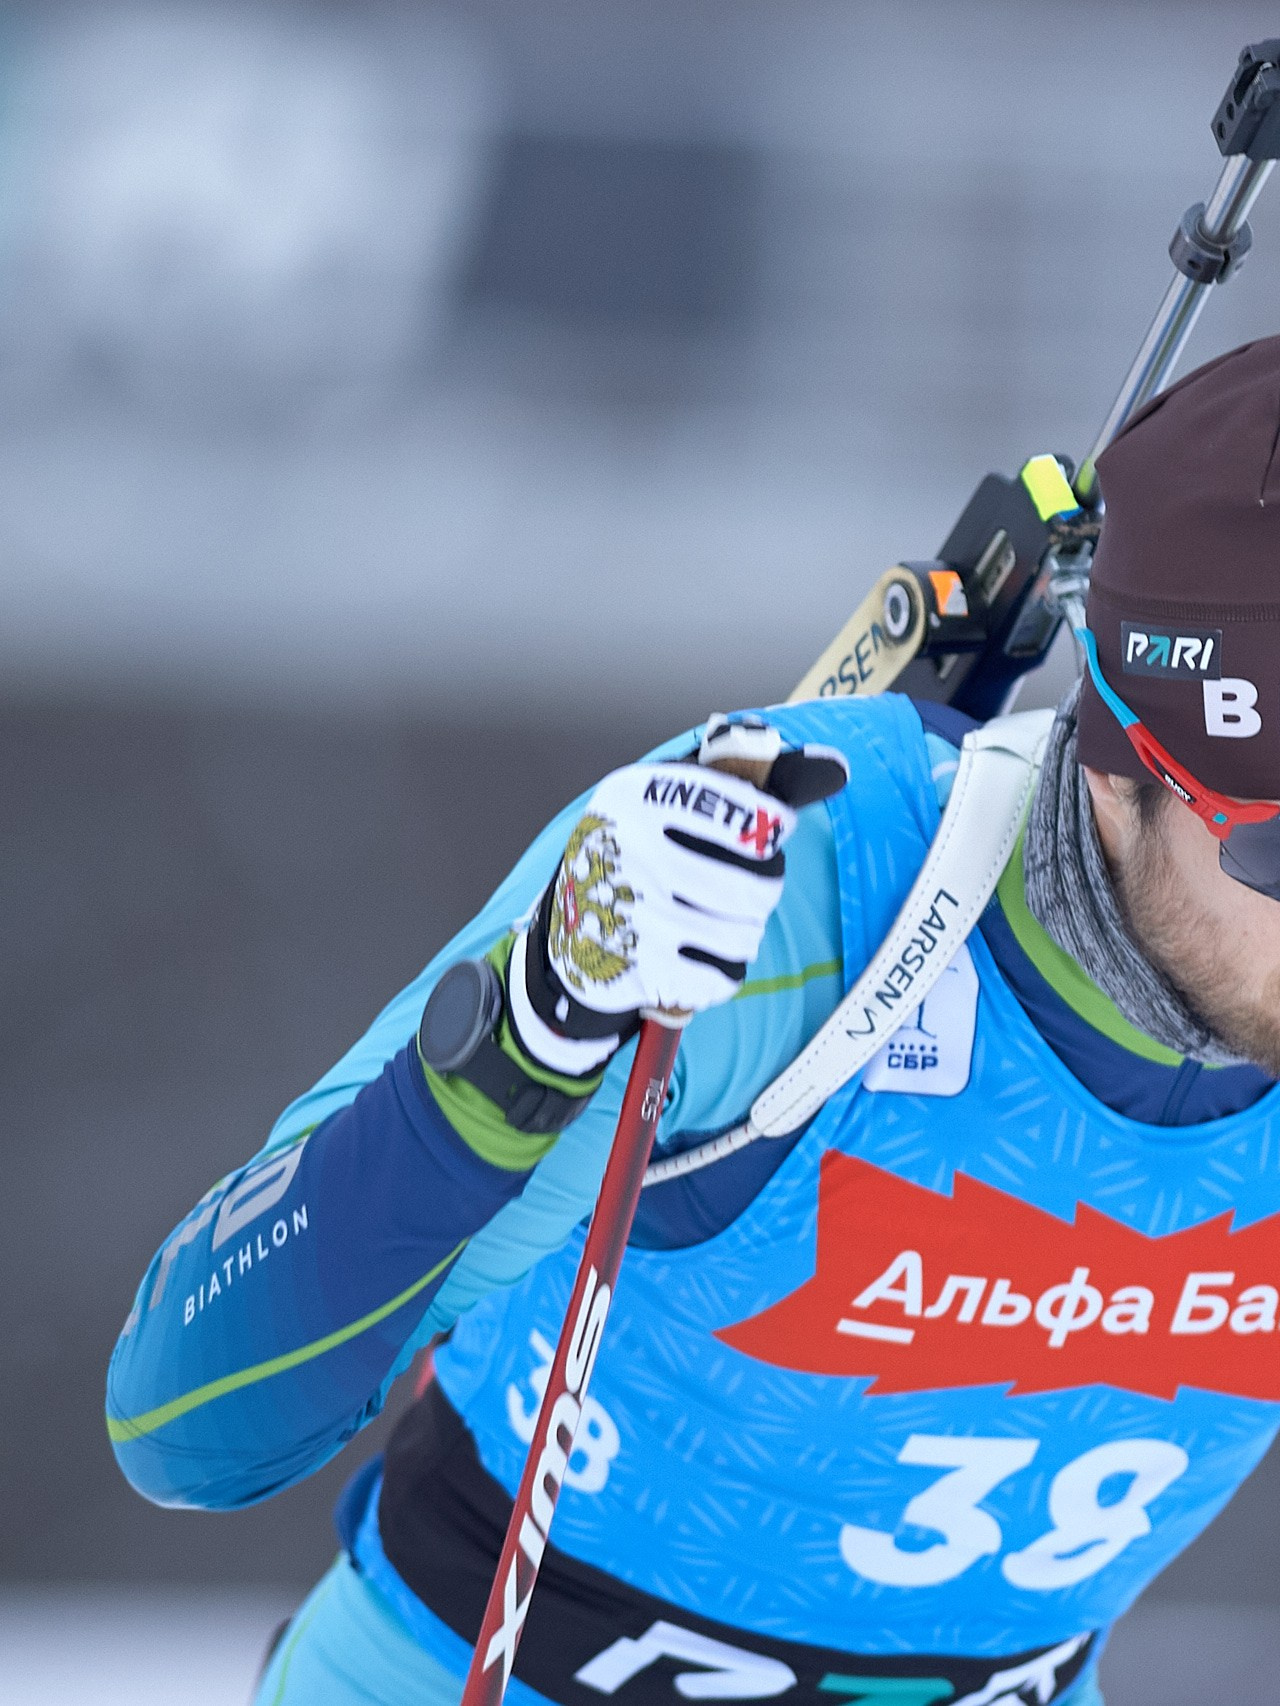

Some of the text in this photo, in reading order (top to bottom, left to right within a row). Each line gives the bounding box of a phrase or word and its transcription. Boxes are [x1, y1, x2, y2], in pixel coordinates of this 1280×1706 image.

[1127, 632, 1214, 670] PARI
[875, 888, 959, 1010] LARSEN
[887, 1054, 939, 1071] СБР
[184, 1204, 309, 1326] BIATHLON
[837, 1250, 1155, 1348] Альфа
[482, 1264, 612, 1697] SWIX
[838, 1434, 1190, 1591] 38
